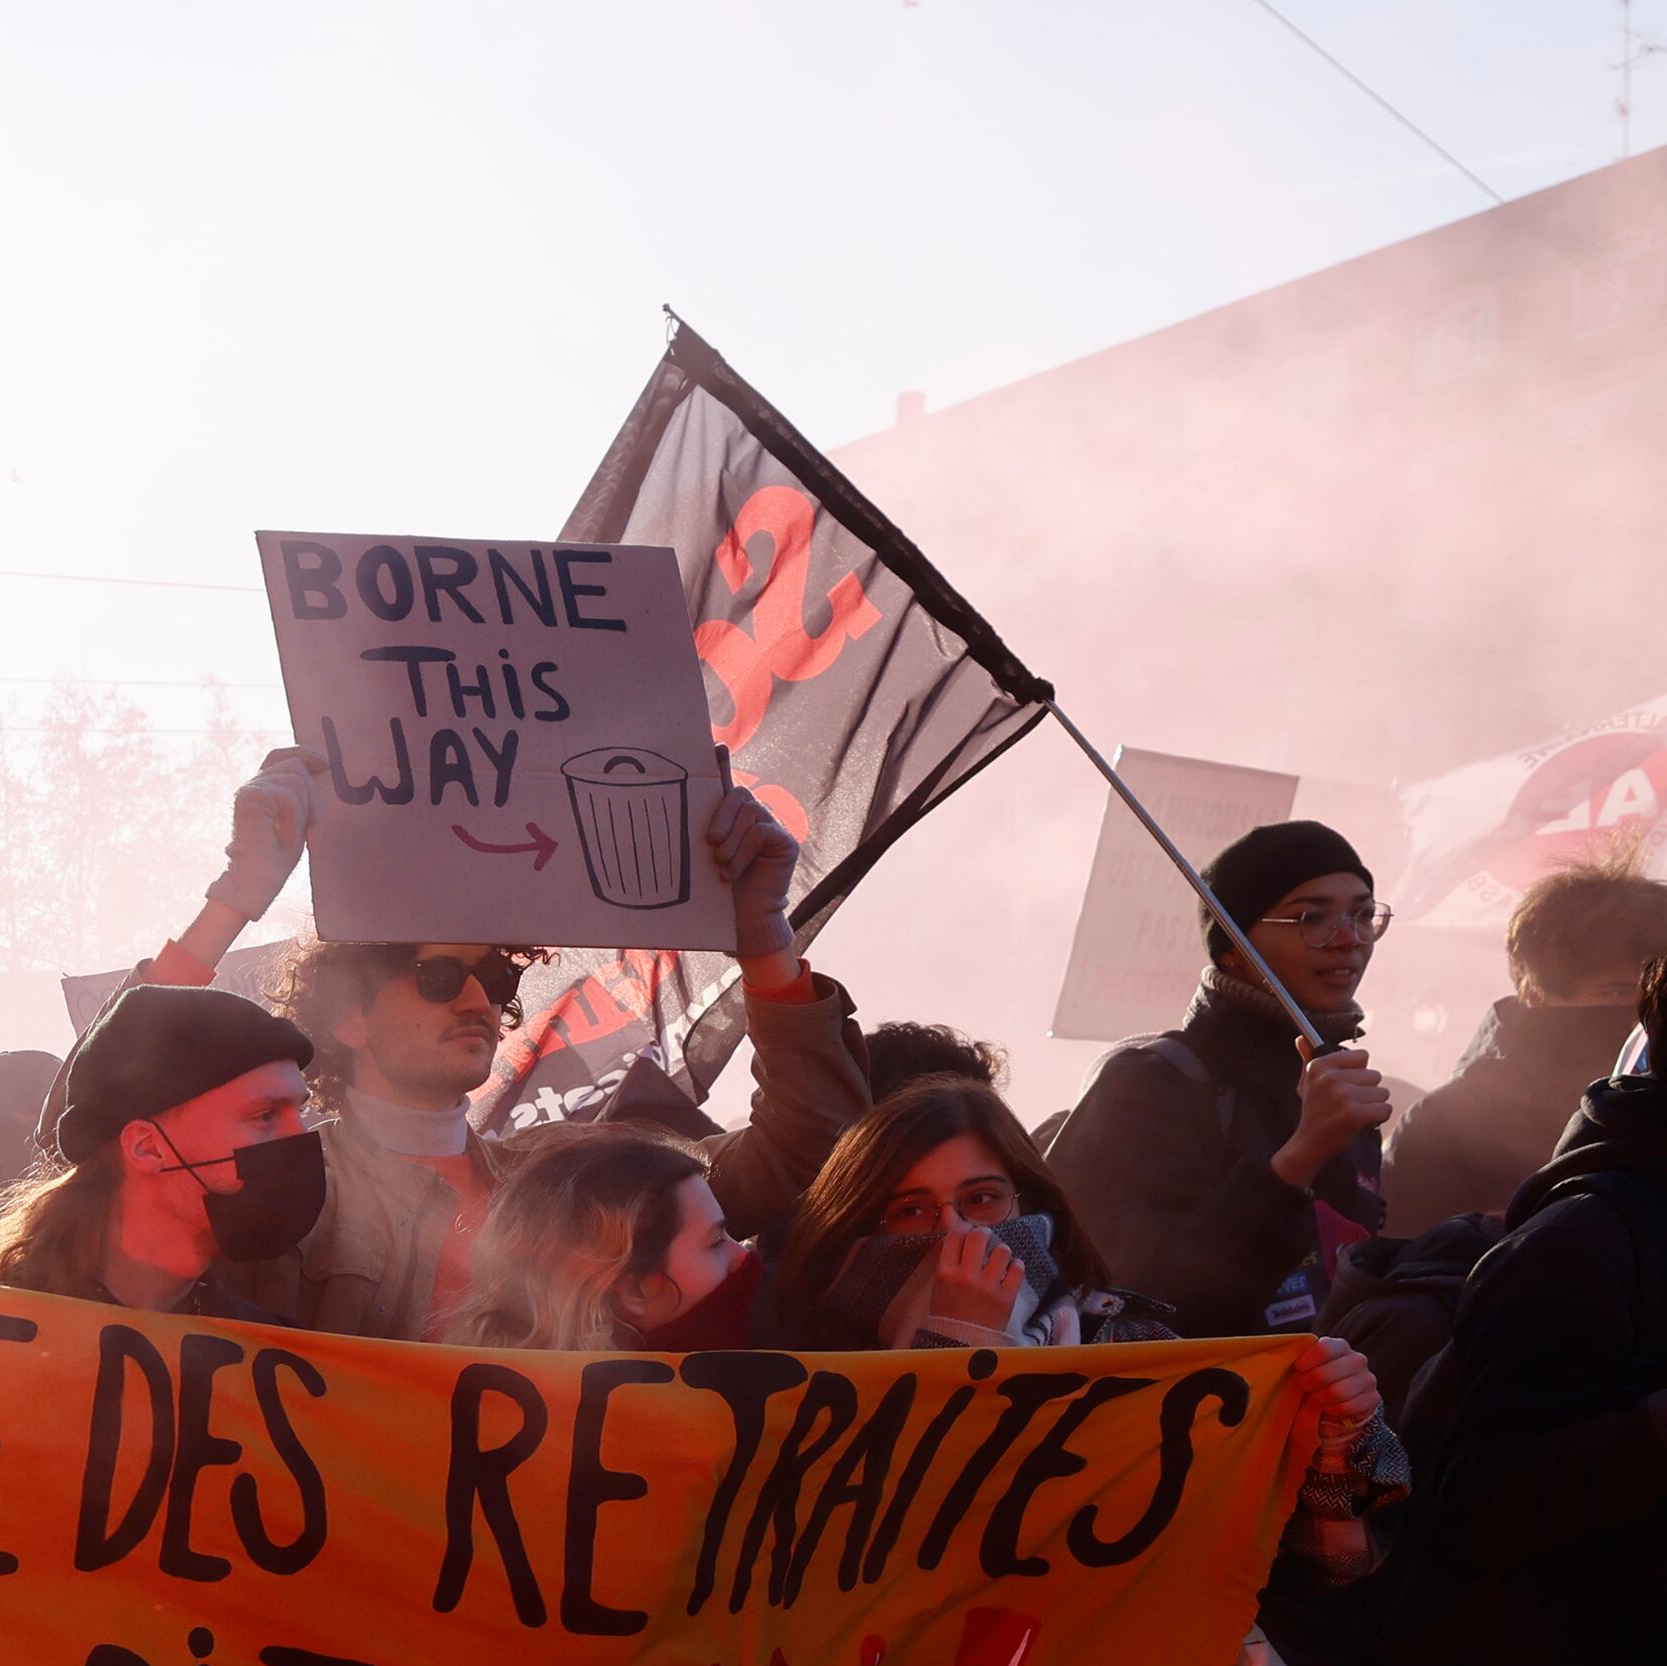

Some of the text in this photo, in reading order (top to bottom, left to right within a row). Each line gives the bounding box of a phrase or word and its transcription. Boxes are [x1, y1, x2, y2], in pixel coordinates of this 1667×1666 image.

[279, 540, 627, 632] BORNE
[320, 716, 520, 808] WAY
[73, 1323, 328, 1582] DES
